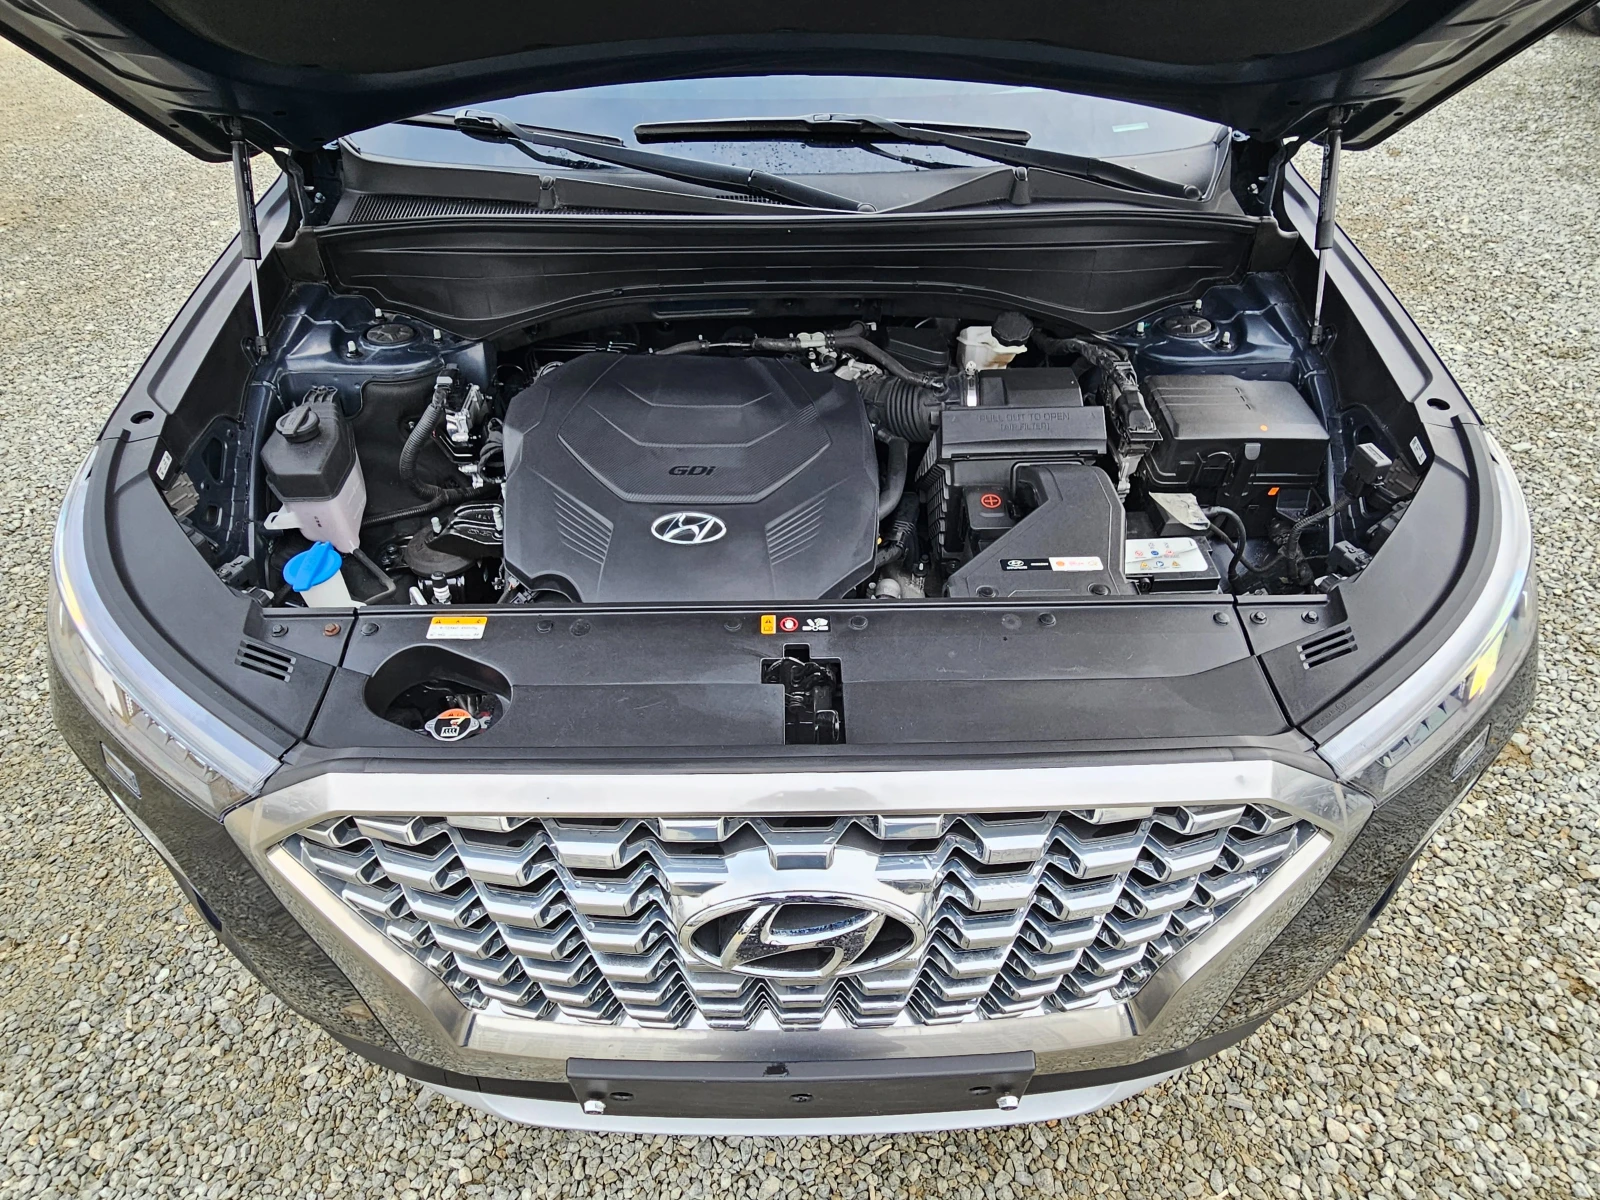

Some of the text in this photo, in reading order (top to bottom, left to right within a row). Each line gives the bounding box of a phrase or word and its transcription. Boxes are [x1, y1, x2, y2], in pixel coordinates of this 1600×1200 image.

[979, 411, 1070, 422] PULL OUT TO OPEN
[668, 465, 716, 476] GDi
